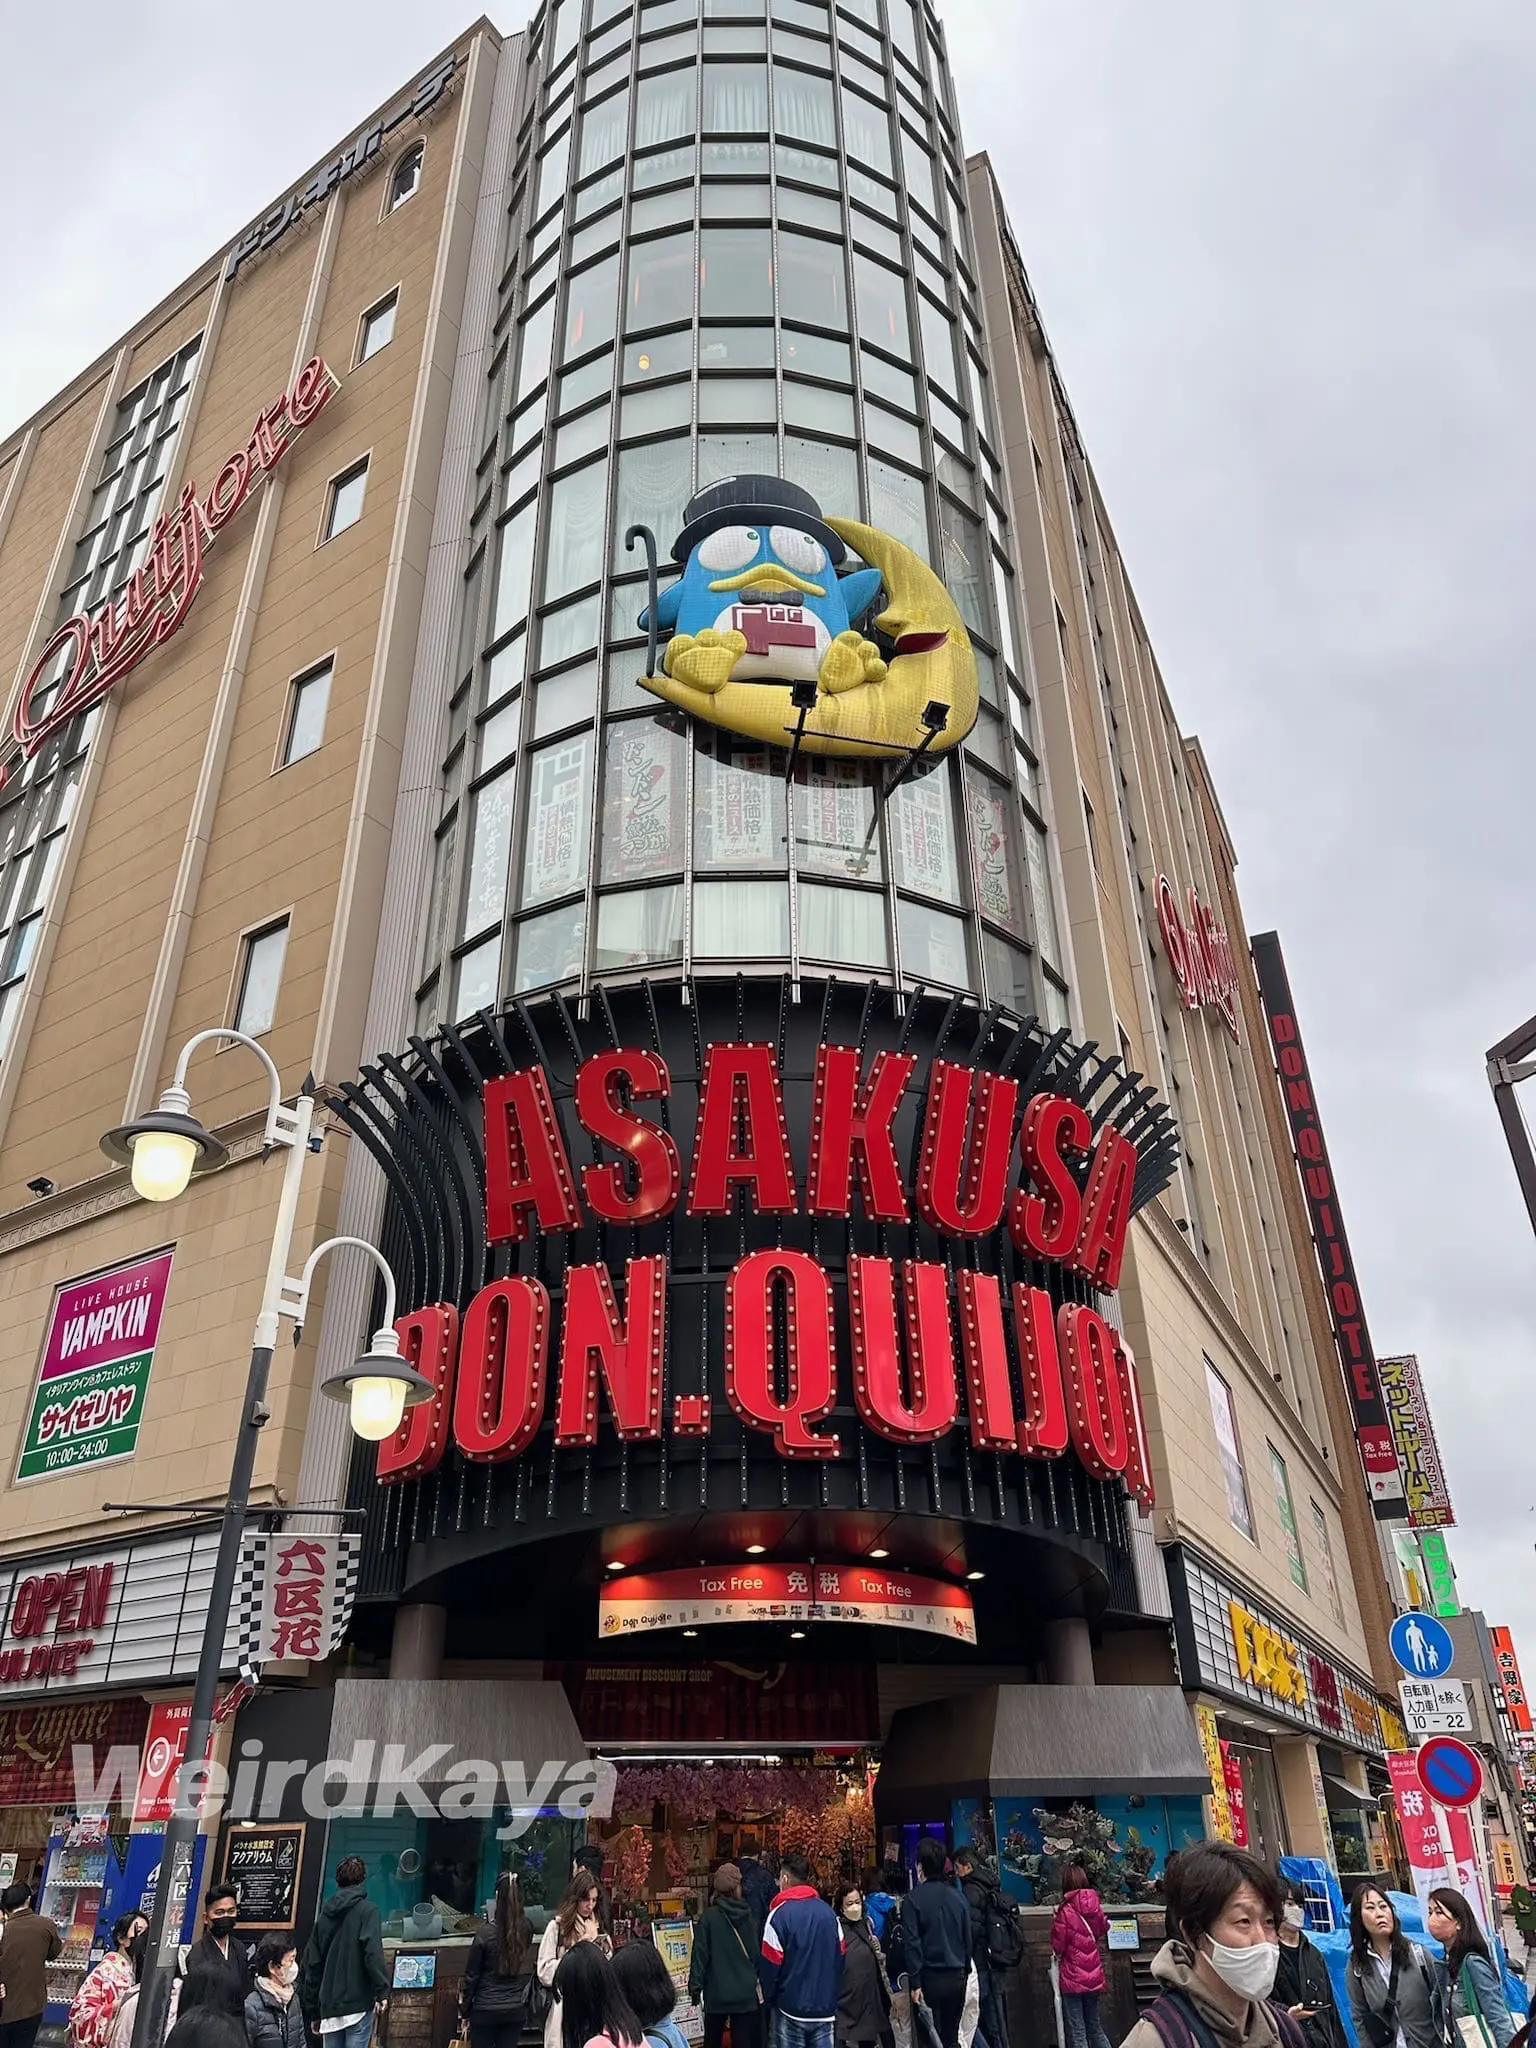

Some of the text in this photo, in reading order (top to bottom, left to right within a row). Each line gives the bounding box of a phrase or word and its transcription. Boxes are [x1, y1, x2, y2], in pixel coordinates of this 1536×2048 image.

[13, 355, 330, 758] Quijote
[483, 1041, 1139, 1294] ASAKUSA
[74, 1276, 150, 1312] LIVE HOUSE
[60, 1293, 152, 1361] VAMPKIN
[37, 1384, 137, 1445] サイゼリヤ
[1379, 1360, 1433, 1496] ネットルーム
[46, 1438, 109, 1468] 10:00-24:00
[1364, 1440, 1391, 1453] 免税
[700, 1576, 763, 1593] Tax Free
[787, 1571, 840, 1595] 免税
[860, 1578, 912, 1598] Tax Free
[11, 1562, 114, 1640] OPEN
[269, 1540, 327, 1659] 六区花
[622, 1613, 672, 1627] Don Quijote
[586, 1668, 712, 1682] AMUSEMENT DISCOUNT SHOP
[1403, 1683, 1463, 1705] 自転車 を除く
[1408, 1698, 1436, 1713] 人力車
[1412, 1715, 1427, 1730] 10
[1446, 1714, 1465, 1728] 22
[231, 1850, 273, 1865] アクアリウム
[165, 1857, 193, 1948] 六区花道
